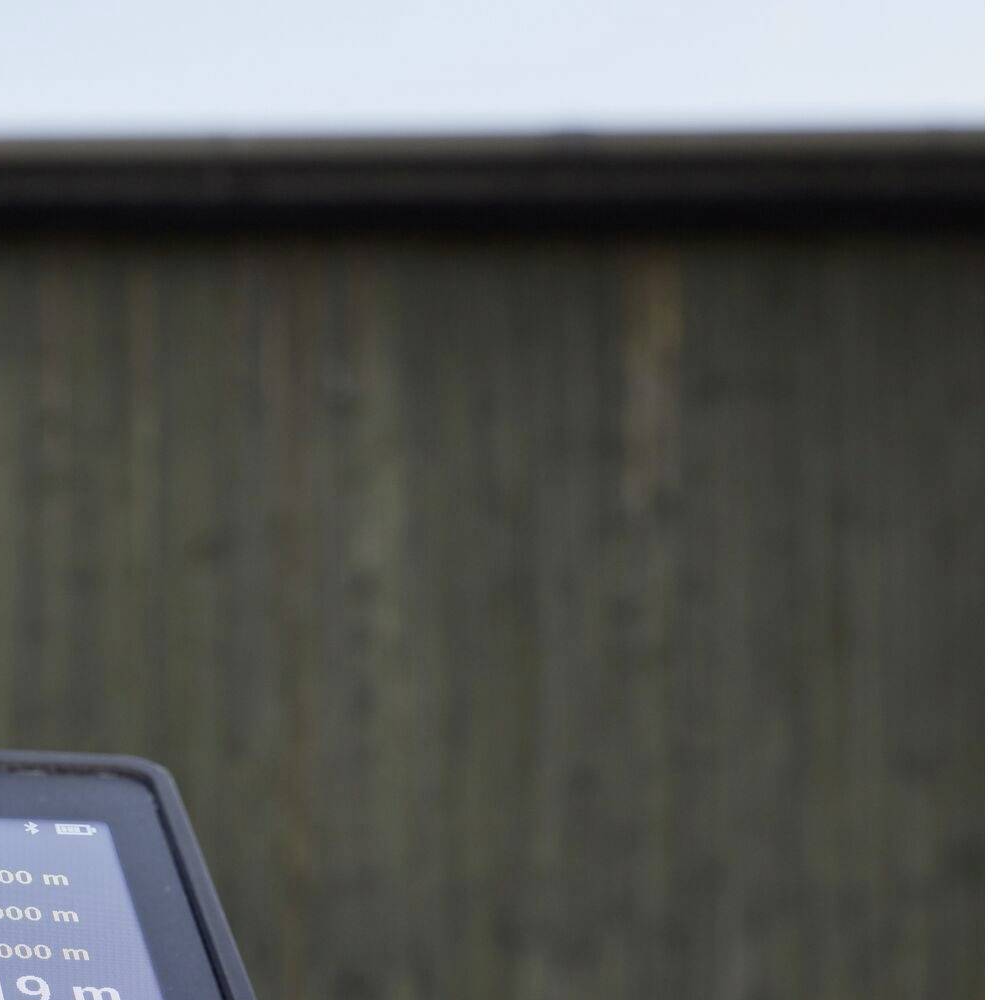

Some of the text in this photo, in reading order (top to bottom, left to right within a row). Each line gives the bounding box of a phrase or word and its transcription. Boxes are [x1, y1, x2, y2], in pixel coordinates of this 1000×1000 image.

[42, 871, 70, 887] m
[52, 908, 80, 923] m
[62, 945, 91, 962] m
